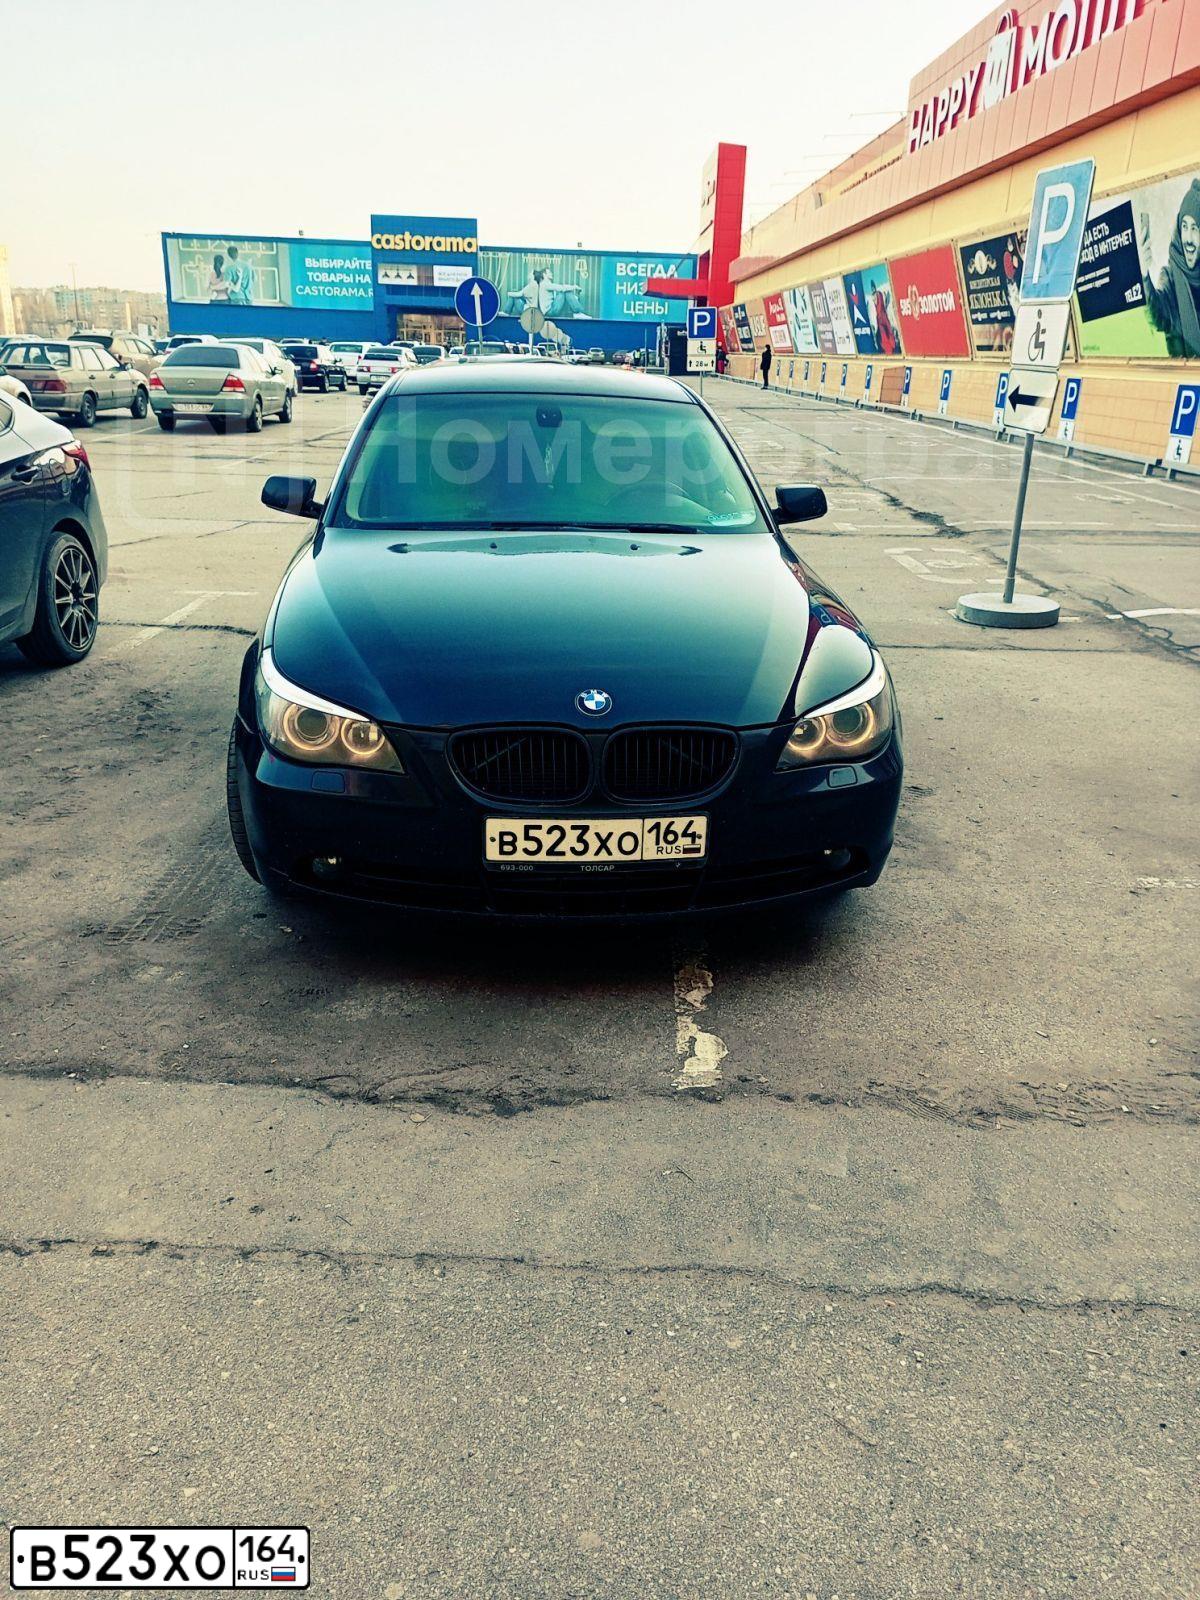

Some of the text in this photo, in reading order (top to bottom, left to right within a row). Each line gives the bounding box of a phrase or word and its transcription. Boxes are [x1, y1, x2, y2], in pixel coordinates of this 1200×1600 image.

[908, 62, 986, 152] HAPPY
[371, 231, 478, 253] castorama
[1032, 182, 1075, 284] P
[1093, 222, 1109, 241] ЕСТЬ
[1094, 244, 1099, 258] В
[1098, 228, 1132, 256] ИНТЕРНЕТ
[304, 256, 372, 270] ВЫБИРАЙТЕ
[616, 262, 678, 278] ВСЕГДА
[307, 272, 371, 284] ТОВАРЫ НА
[616, 281, 645, 296] НИЗ
[623, 301, 669, 316] ЦЕНЫ
[919, 288, 955, 314] ЗОЛОТОЙ
[693, 311, 711, 336] P
[942, 371, 950, 395] P
[998, 376, 1008, 404] P
[1064, 381, 1078, 415] P
[1175, 390, 1196, 430] P
[498, 820, 698, 857] В523ХО 164
[656, 845, 682, 855] RUS
[580, 864, 615, 872] ТОЛСАР
